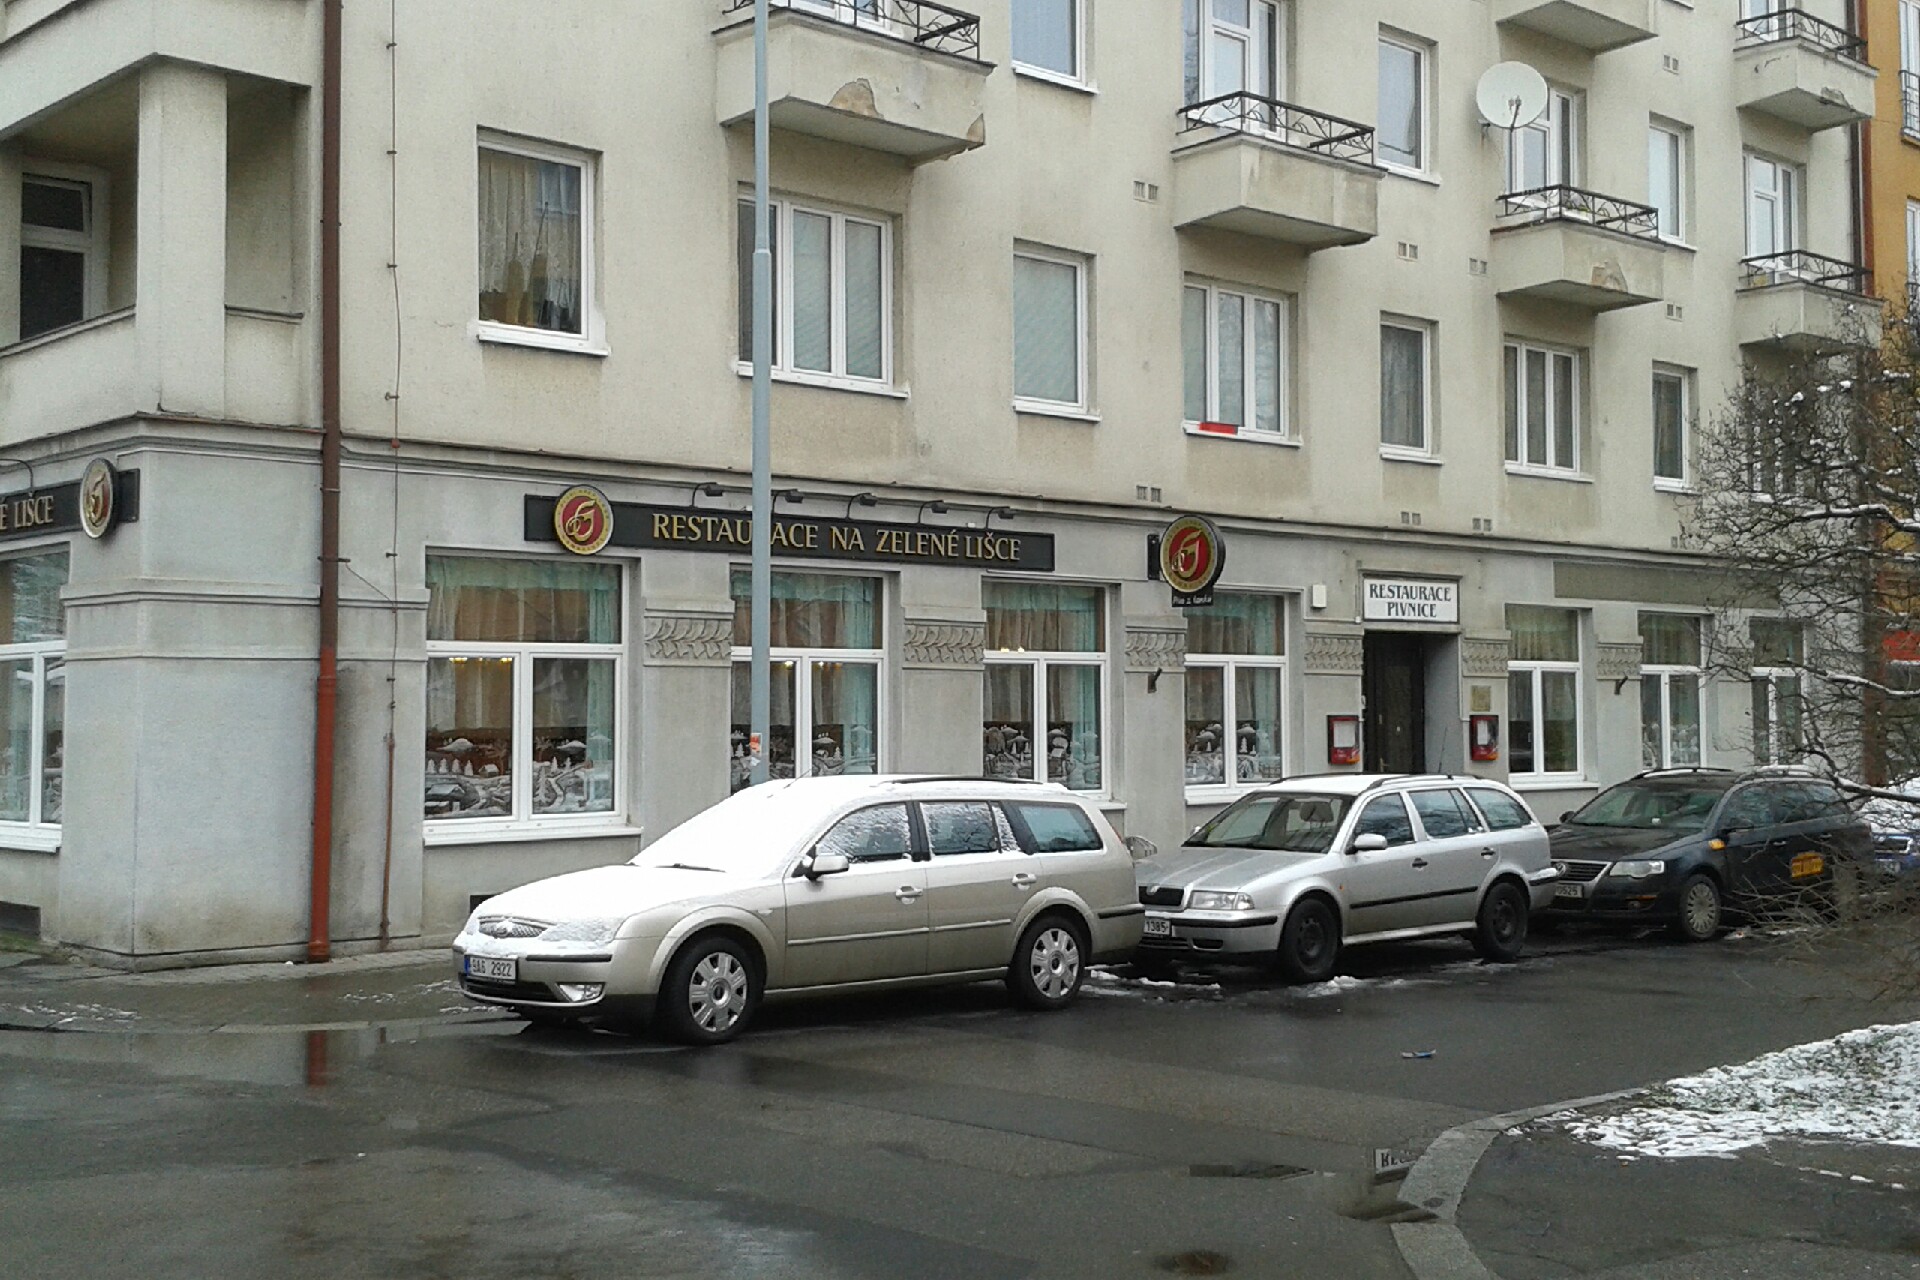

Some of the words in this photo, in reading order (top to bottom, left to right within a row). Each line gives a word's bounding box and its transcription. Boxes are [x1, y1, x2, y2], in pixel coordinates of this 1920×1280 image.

[653, 513, 818, 548] RESTAUACE
[830, 526, 865, 551] NA
[876, 529, 959, 557] ZELENÉ
[965, 531, 1021, 561] LIŠCE
[1369, 583, 1452, 602] RESTAURACE
[1387, 602, 1437, 618] PIVNICE
[491, 960, 512, 978] 2922
